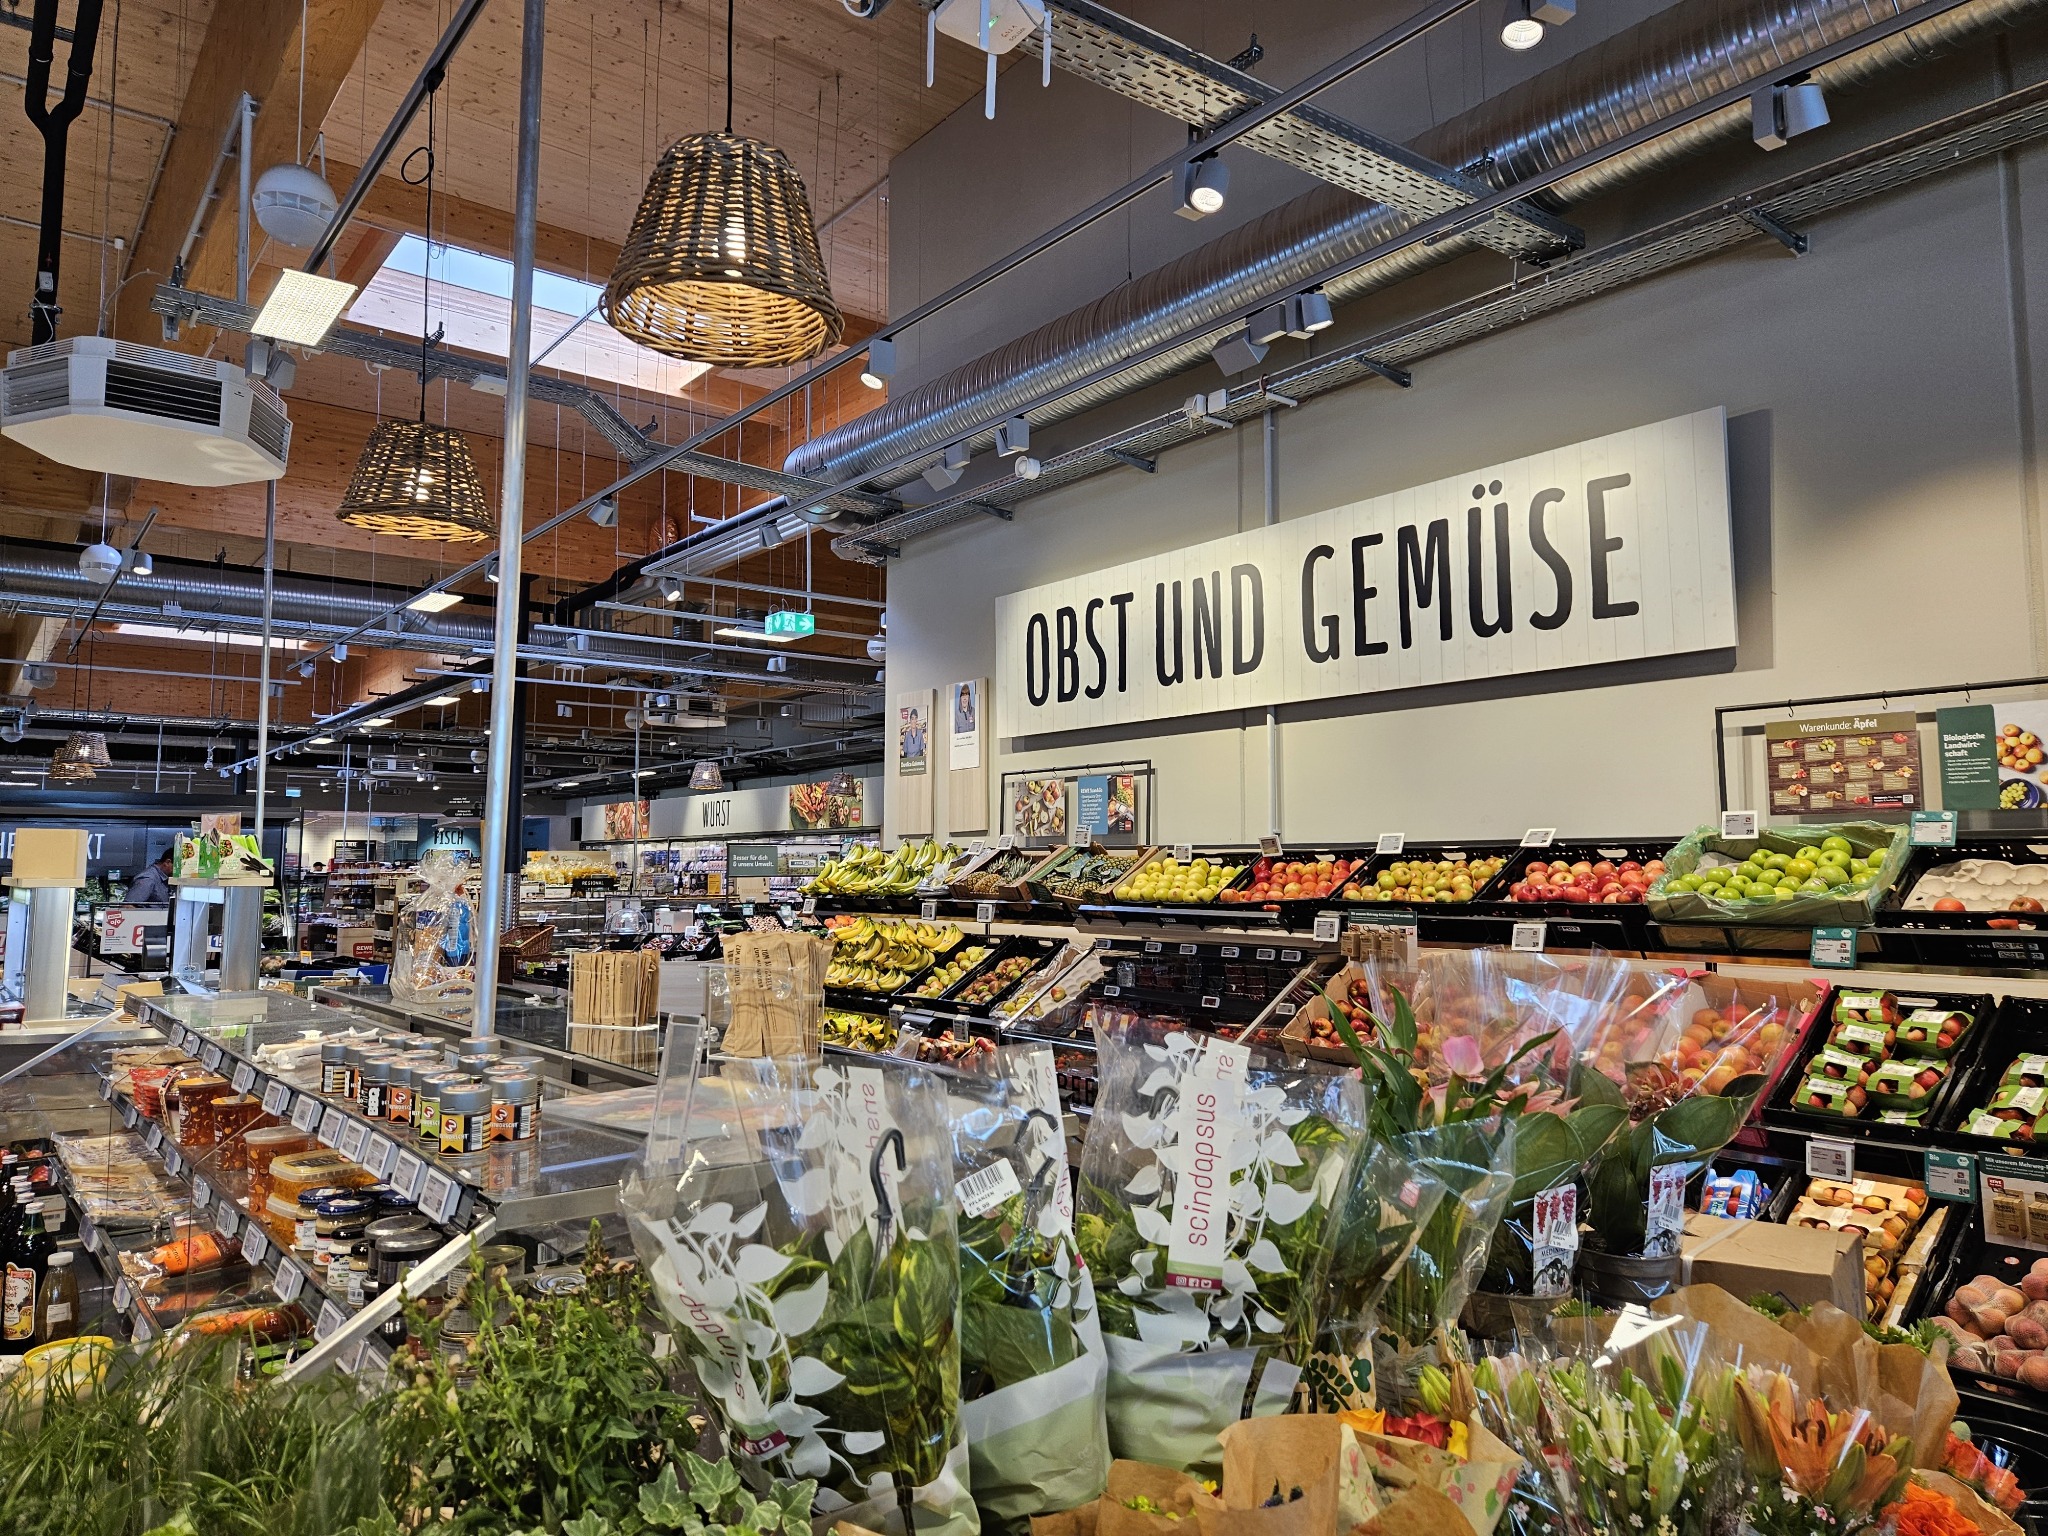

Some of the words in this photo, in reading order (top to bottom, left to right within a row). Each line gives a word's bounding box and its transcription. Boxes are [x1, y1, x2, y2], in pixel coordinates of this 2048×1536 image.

[1026, 592, 1134, 707] OBST
[1155, 562, 1265, 688] UND
[1301, 471, 1640, 664] GEMÜSE
[1800, 722, 1852, 733] Warenkunde:
[1853, 718, 1878, 731] Äpfel
[1943, 733, 1985, 742] Biologische
[1944, 741, 1981, 750] Landwirt-
[702, 799, 731, 828] WURST
[434, 830, 464, 845] FISCH
[1929, 1153, 1940, 1162] Bio
[1184, 1093, 1222, 1246] scindapsus
[1692, 1455, 1719, 1478] Lieblin
